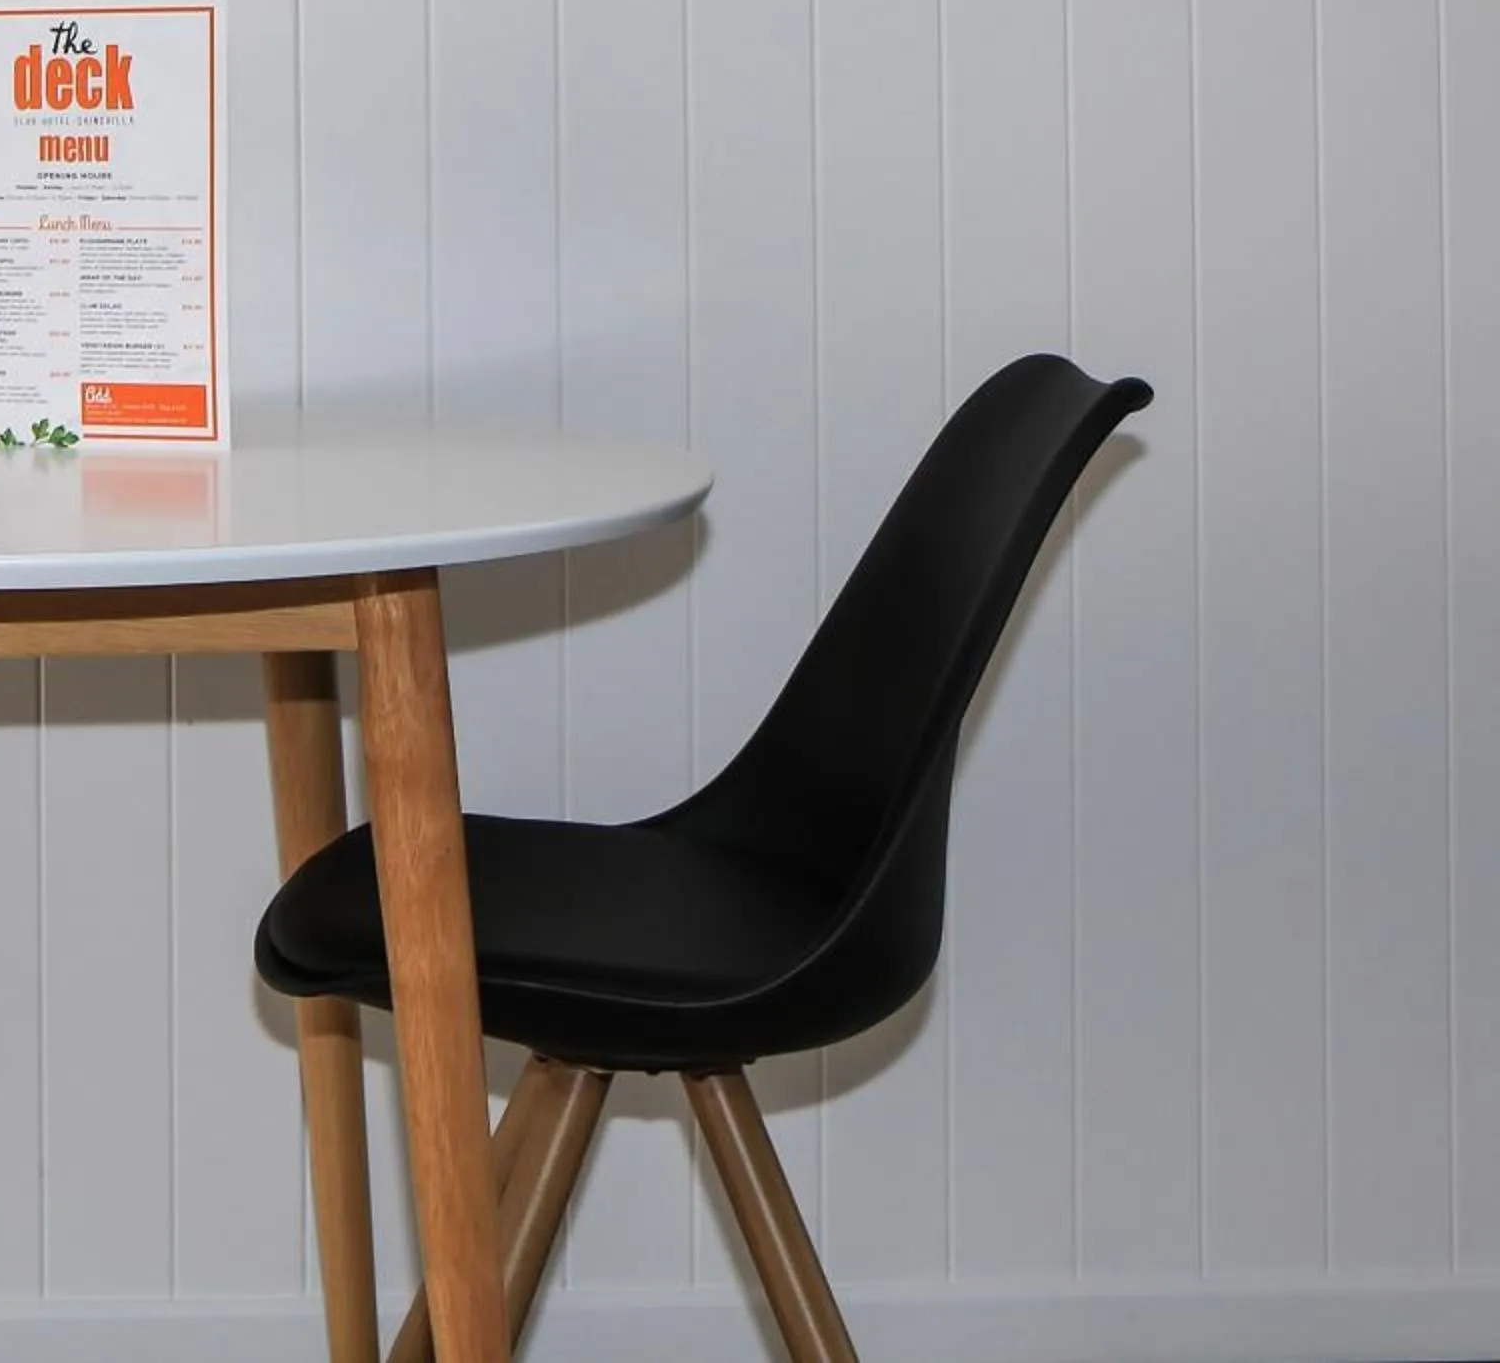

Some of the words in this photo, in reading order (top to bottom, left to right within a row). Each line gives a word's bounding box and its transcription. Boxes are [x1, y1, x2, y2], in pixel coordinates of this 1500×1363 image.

[50, 21, 97, 55] the
[13, 45, 134, 110] deck
[39, 135, 109, 162] menu
[37, 172, 78, 180] OPENING
[80, 172, 112, 180] HOURS
[38, 214, 77, 232] Lunch
[79, 214, 112, 232] Menu
